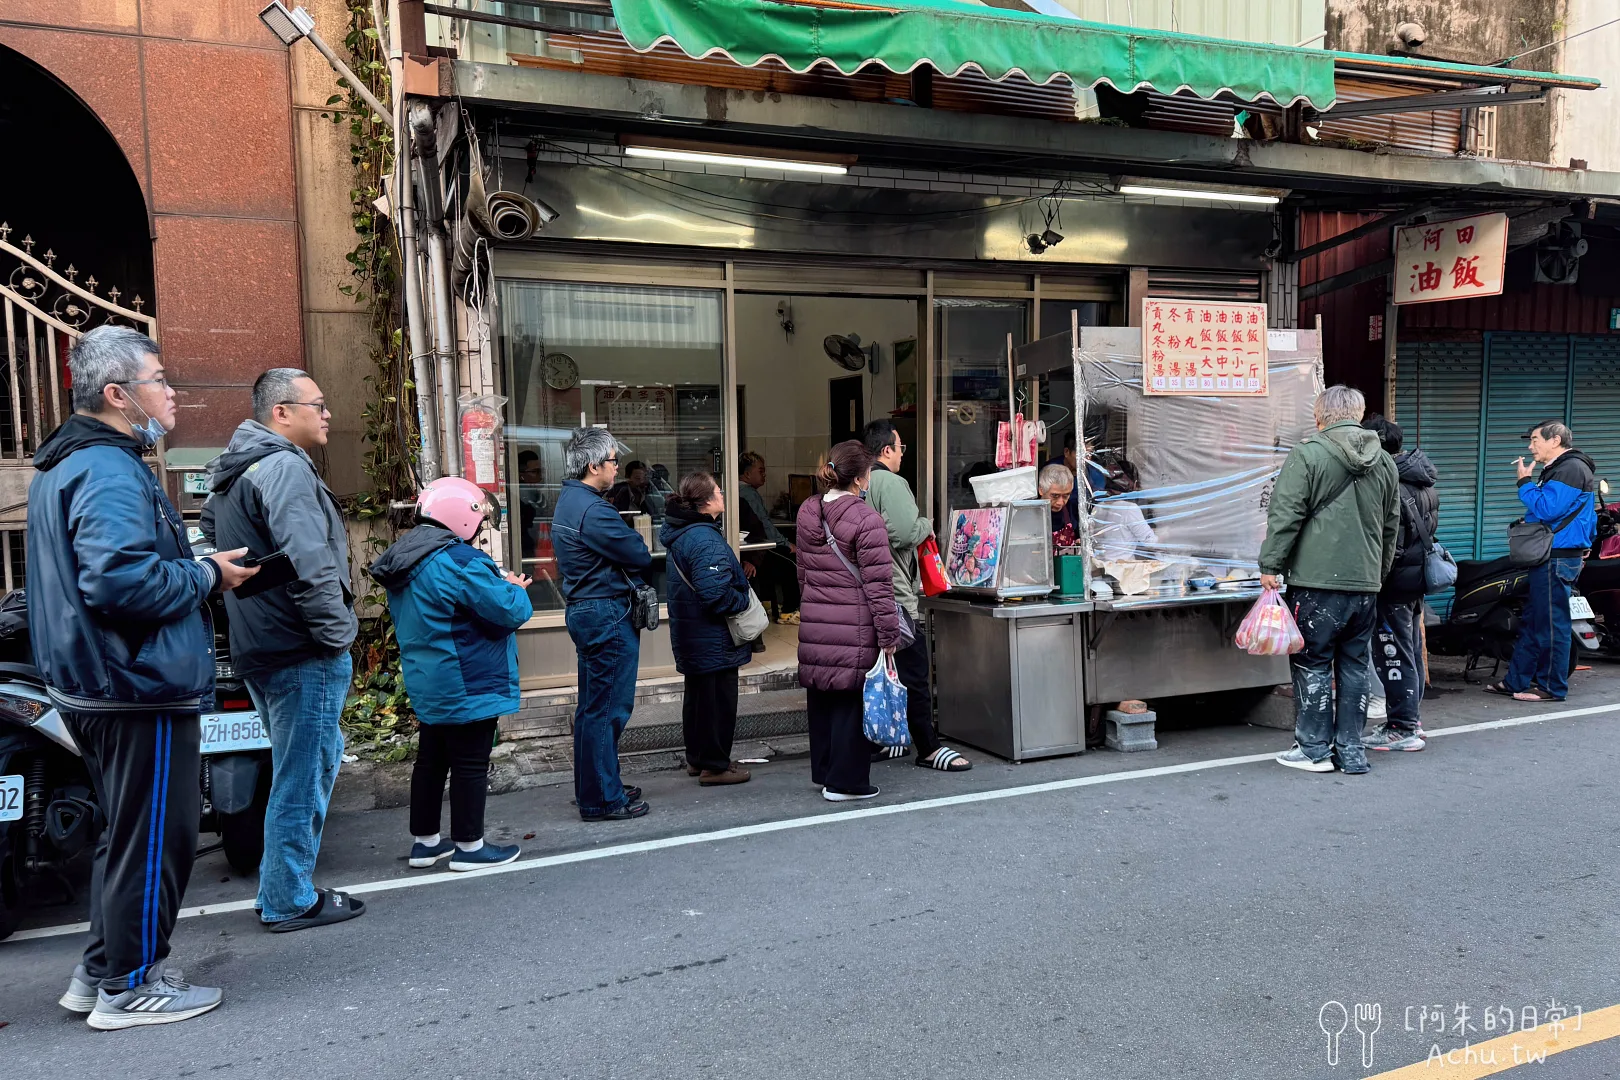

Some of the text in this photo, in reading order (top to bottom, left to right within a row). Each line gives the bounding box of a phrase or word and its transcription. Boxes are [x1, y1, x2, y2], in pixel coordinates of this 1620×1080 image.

[1424, 225, 1475, 252] 阿田
[1410, 255, 1485, 293] 油飯
[1152, 306, 1166, 377] 貢丸冬粉湯
[1168, 307, 1182, 377] 冬粉湯
